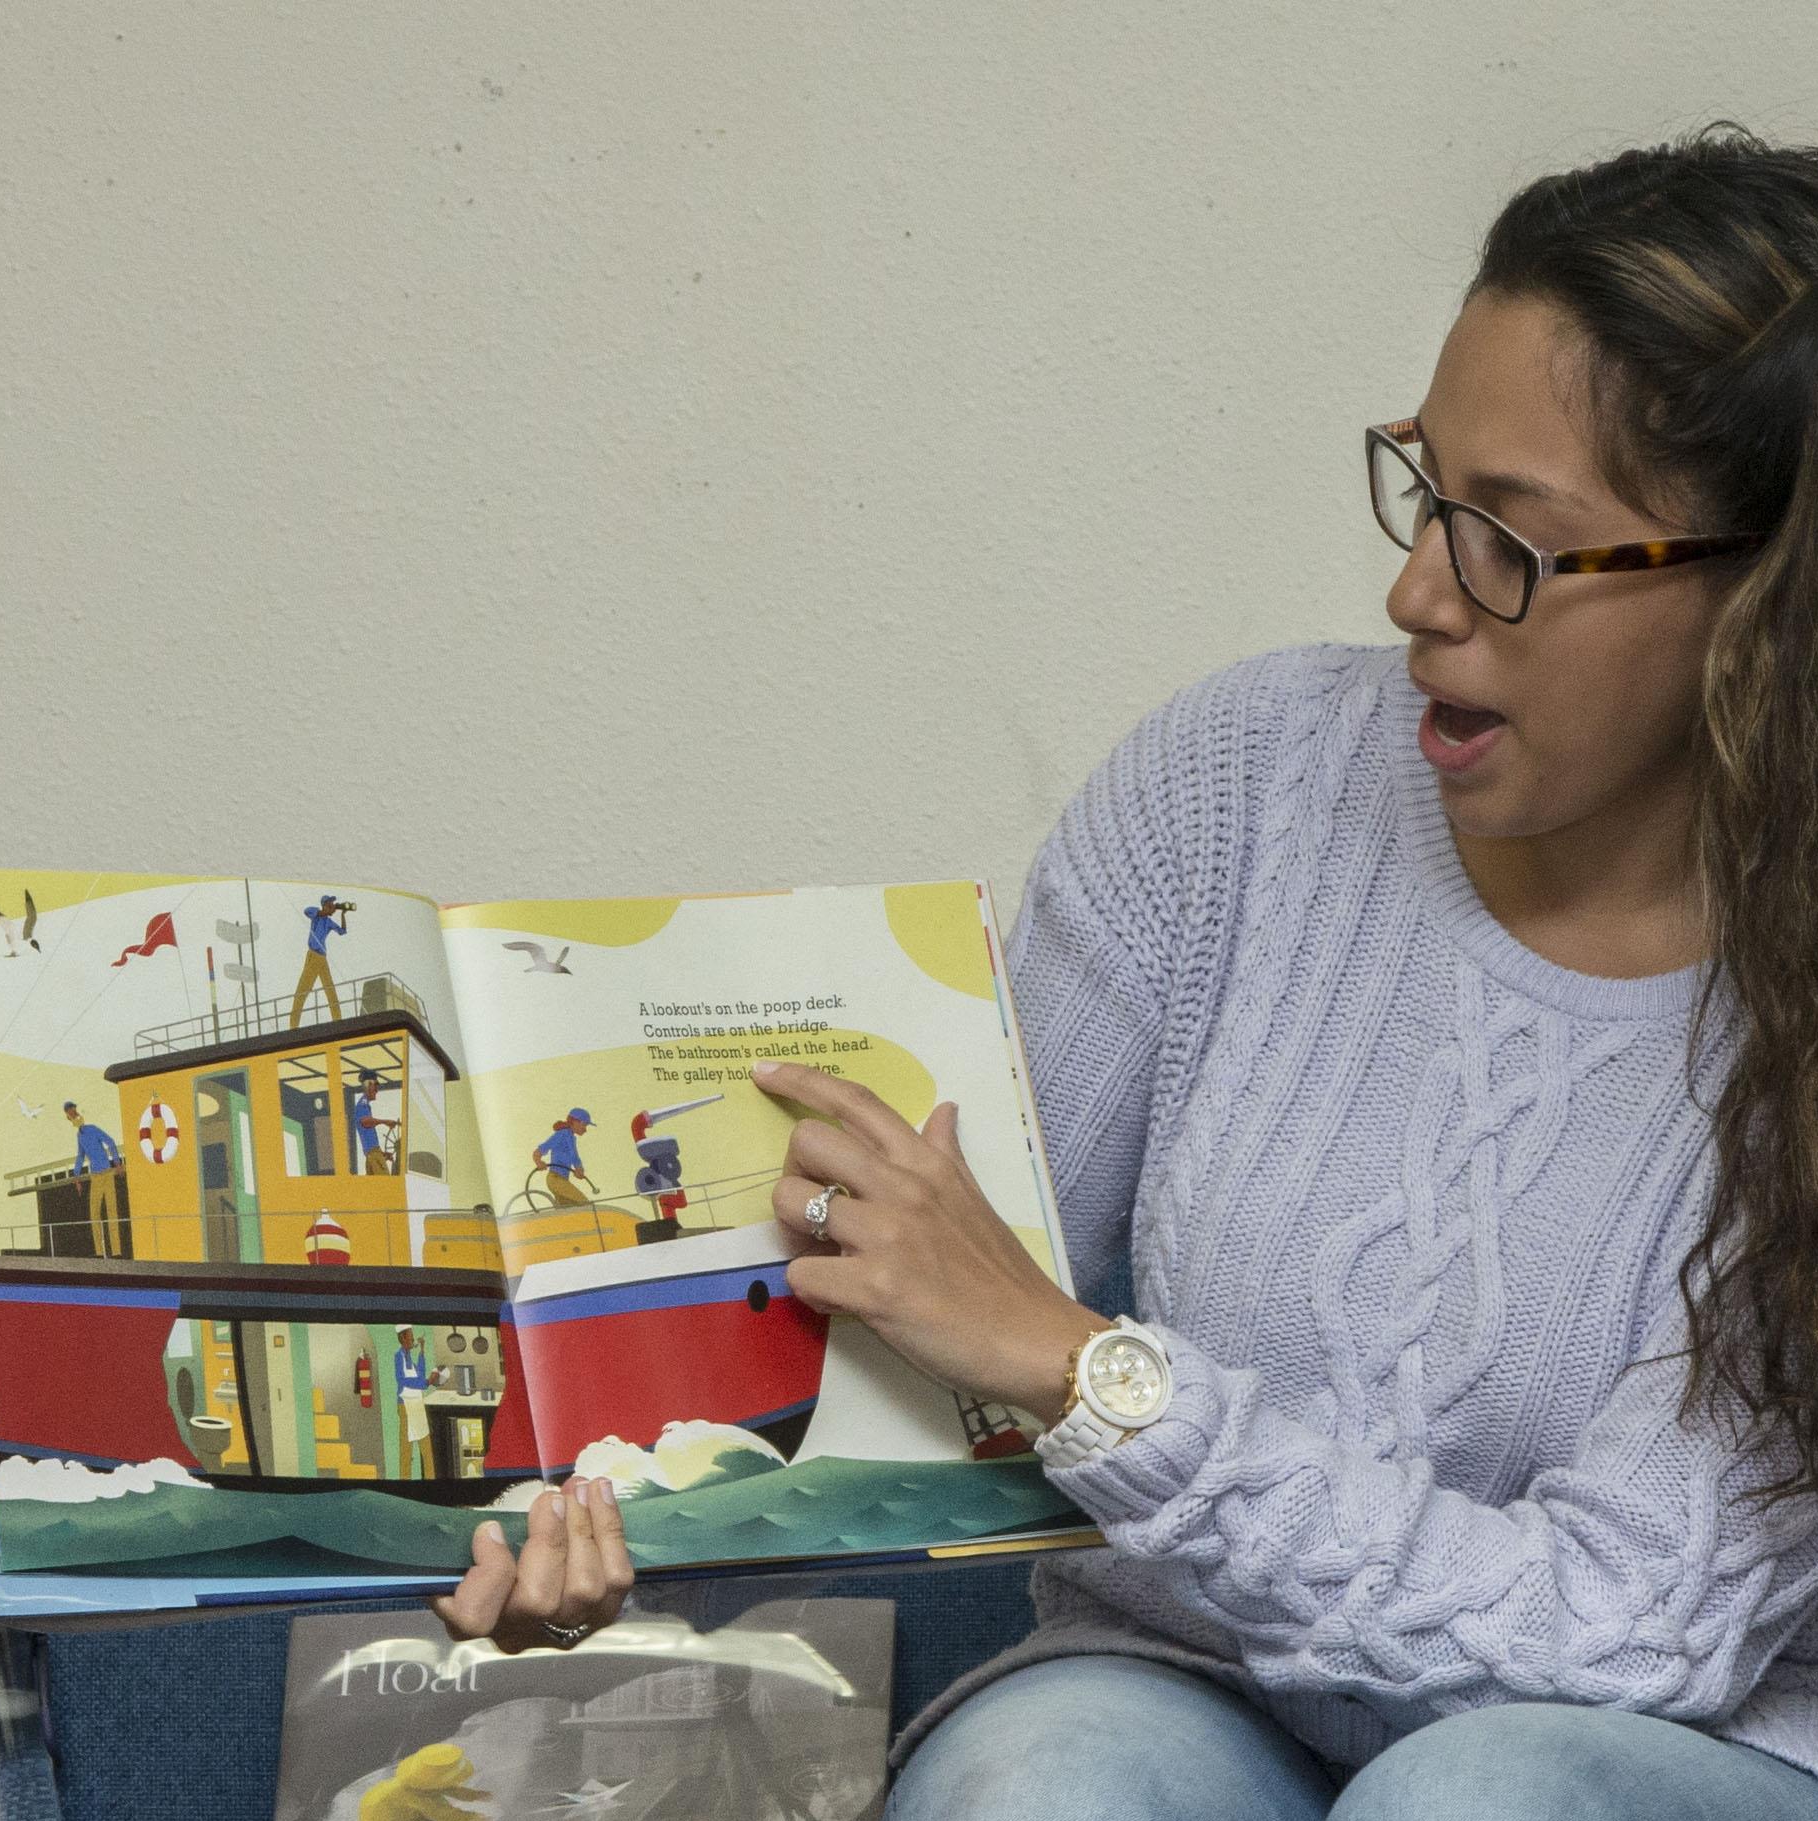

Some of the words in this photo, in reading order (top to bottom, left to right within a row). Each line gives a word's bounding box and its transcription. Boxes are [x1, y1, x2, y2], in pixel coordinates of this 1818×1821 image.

[639, 1002, 649, 1016] A
[651, 1002, 712, 1016] lookout's
[715, 1004, 733, 1015] on
[735, 1001, 758, 1014] the
[763, 1000, 802, 1016] poop
[806, 994, 847, 1010] deck.
[643, 1024, 701, 1038] Controls
[704, 1026, 725, 1037] are
[729, 1026, 747, 1036] on
[749, 1022, 773, 1036] the
[778, 1018, 833, 1035] bridge.
[647, 1046, 673, 1059] The
[676, 1045, 752, 1059] bathroom's
[755, 1042, 801, 1058] called
[803, 1040, 827, 1054] the
[832, 1036, 874, 1052] head.
[652, 1067, 679, 1081] The
[683, 1067, 723, 1085] galley
